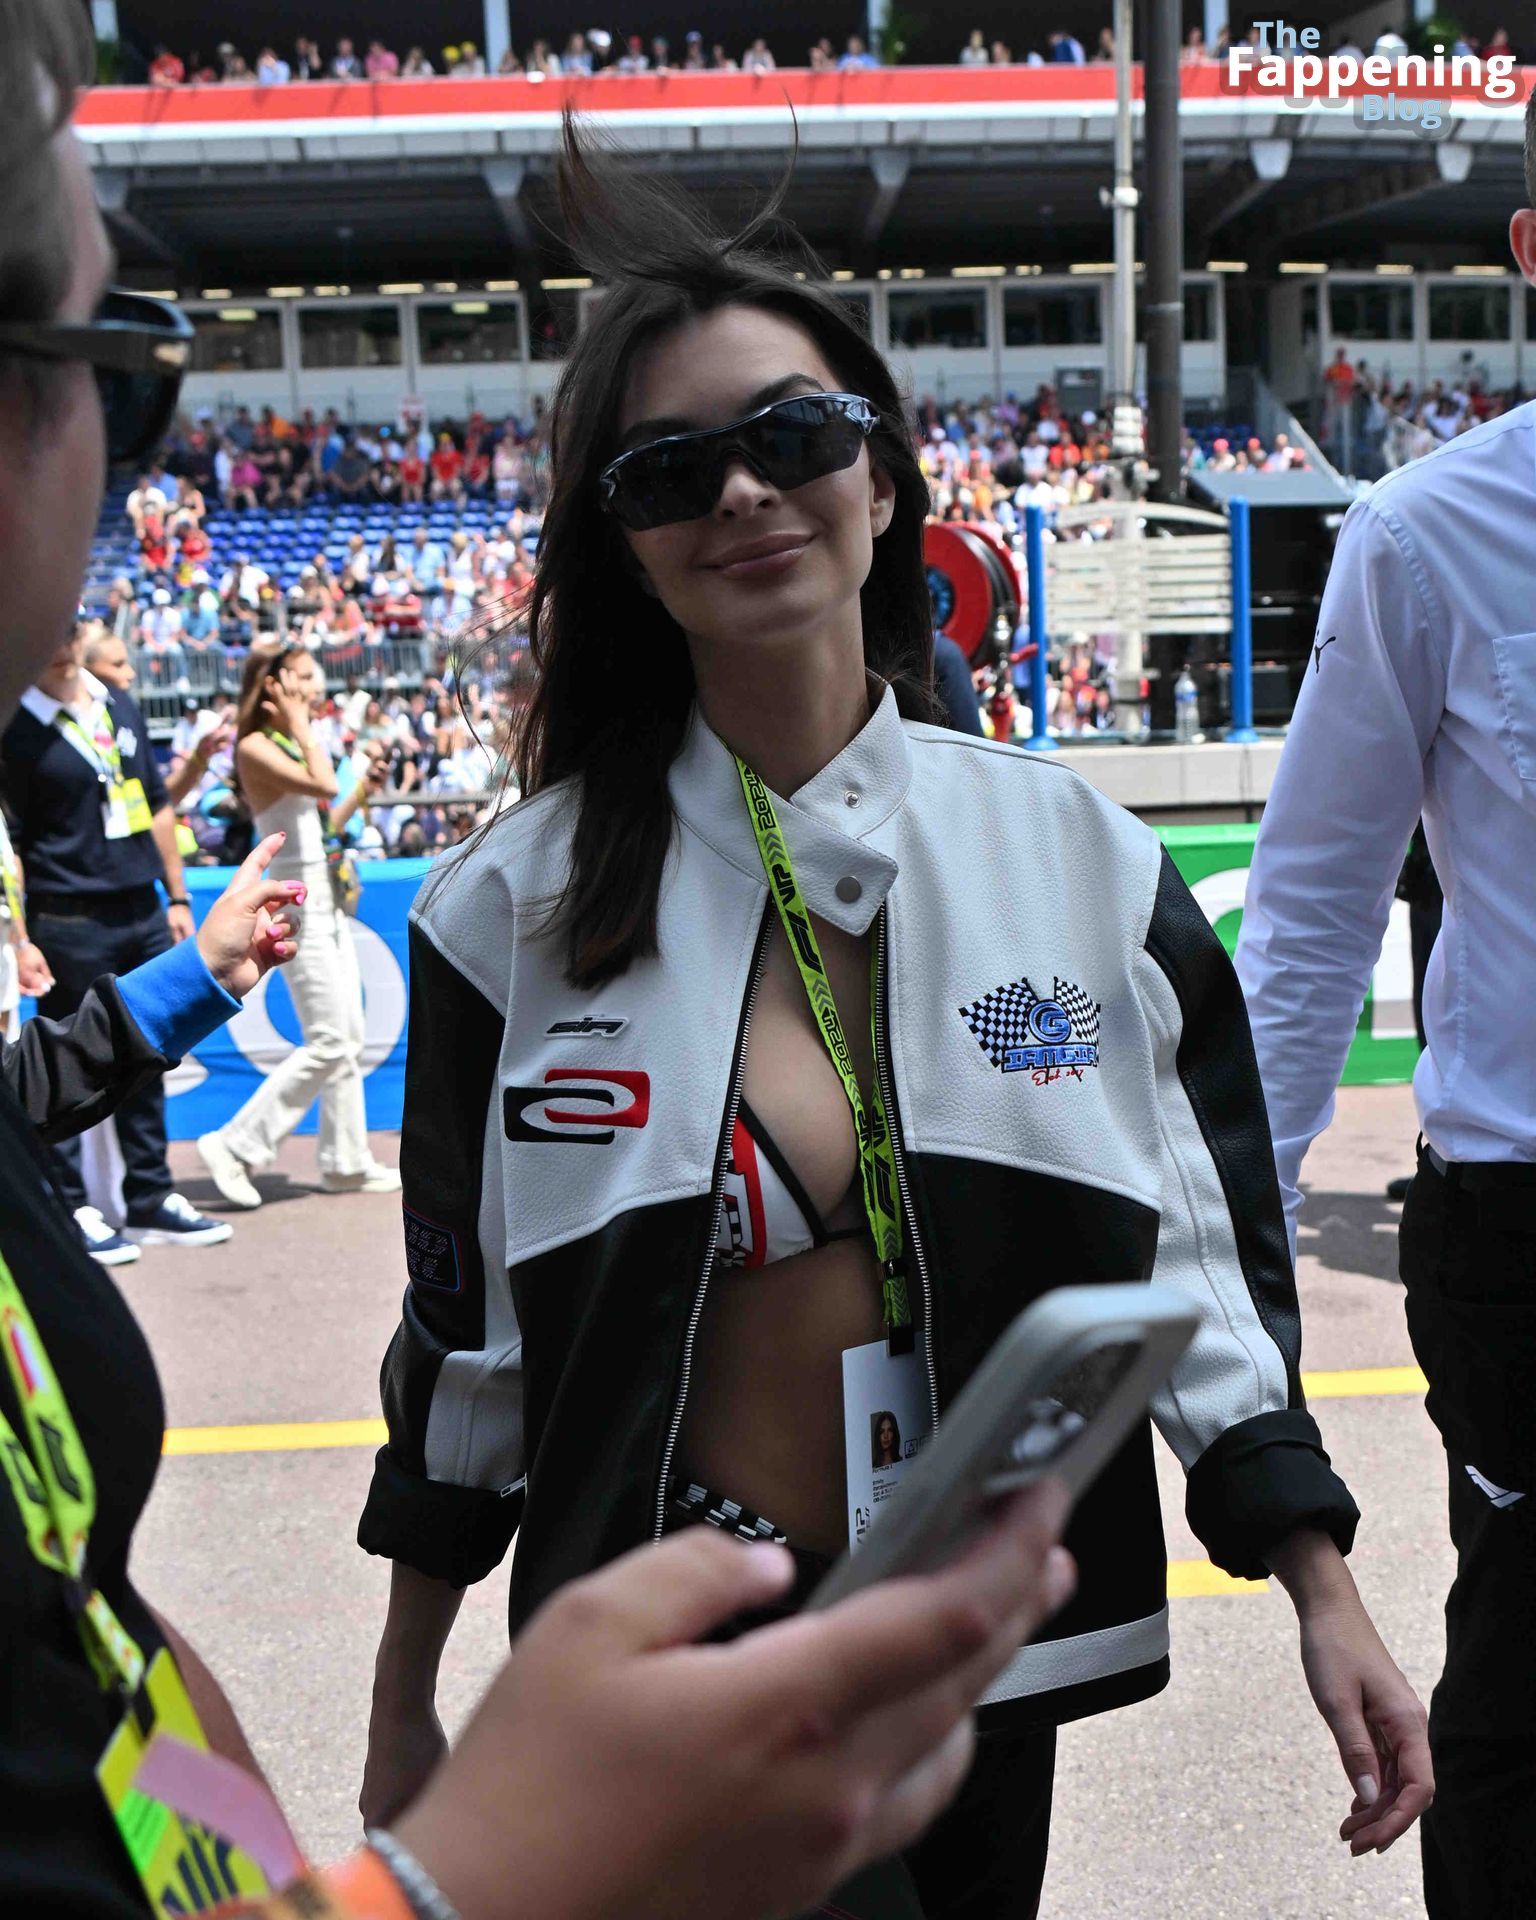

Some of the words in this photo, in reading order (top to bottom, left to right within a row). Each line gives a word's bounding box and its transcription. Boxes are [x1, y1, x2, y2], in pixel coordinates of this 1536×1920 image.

[745, 769, 776, 831] 2024
[771, 863, 796, 906] VIP
[822, 1007, 854, 1076] 2024
